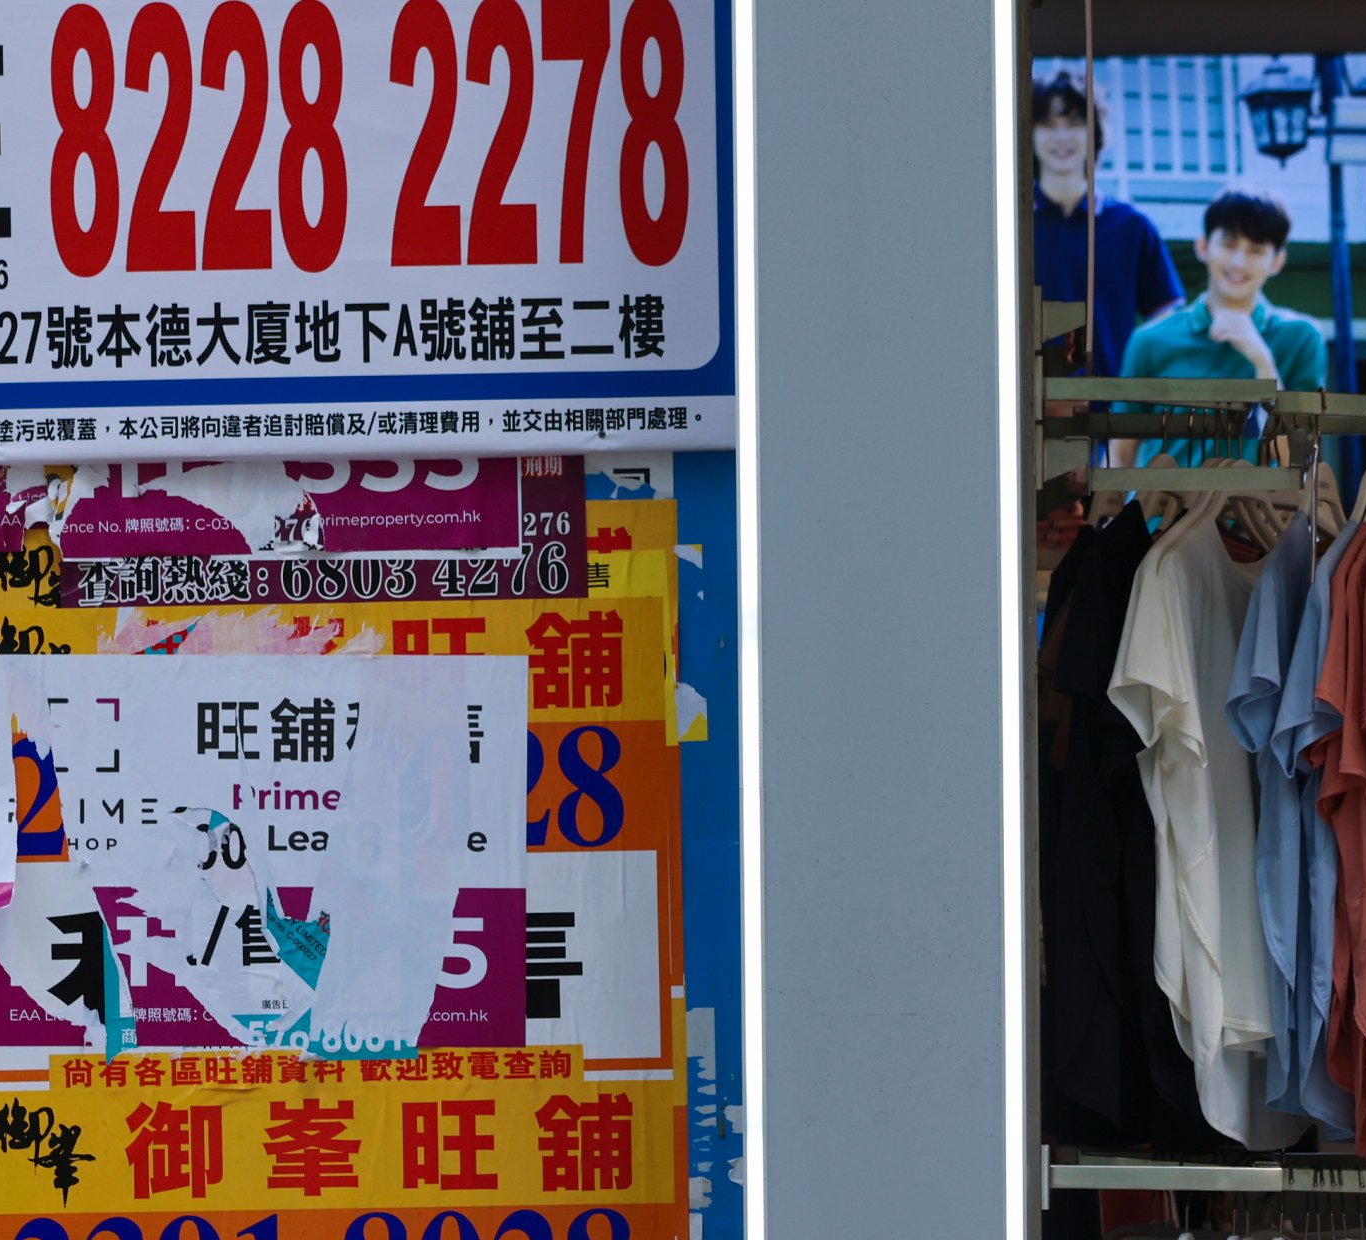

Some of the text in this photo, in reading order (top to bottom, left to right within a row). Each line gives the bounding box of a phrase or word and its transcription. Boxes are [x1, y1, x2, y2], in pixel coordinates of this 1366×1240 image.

[50, 1, 348, 278] 8228
[389, 0, 689, 268] 2278
[281, 557, 417, 600] 6803
[433, 541, 570, 598] 4276
[10, 1009, 41, 1022] EAA
[63, 1049, 572, 1088] 尚有各區旺舖資料 歡迎致電查詢
